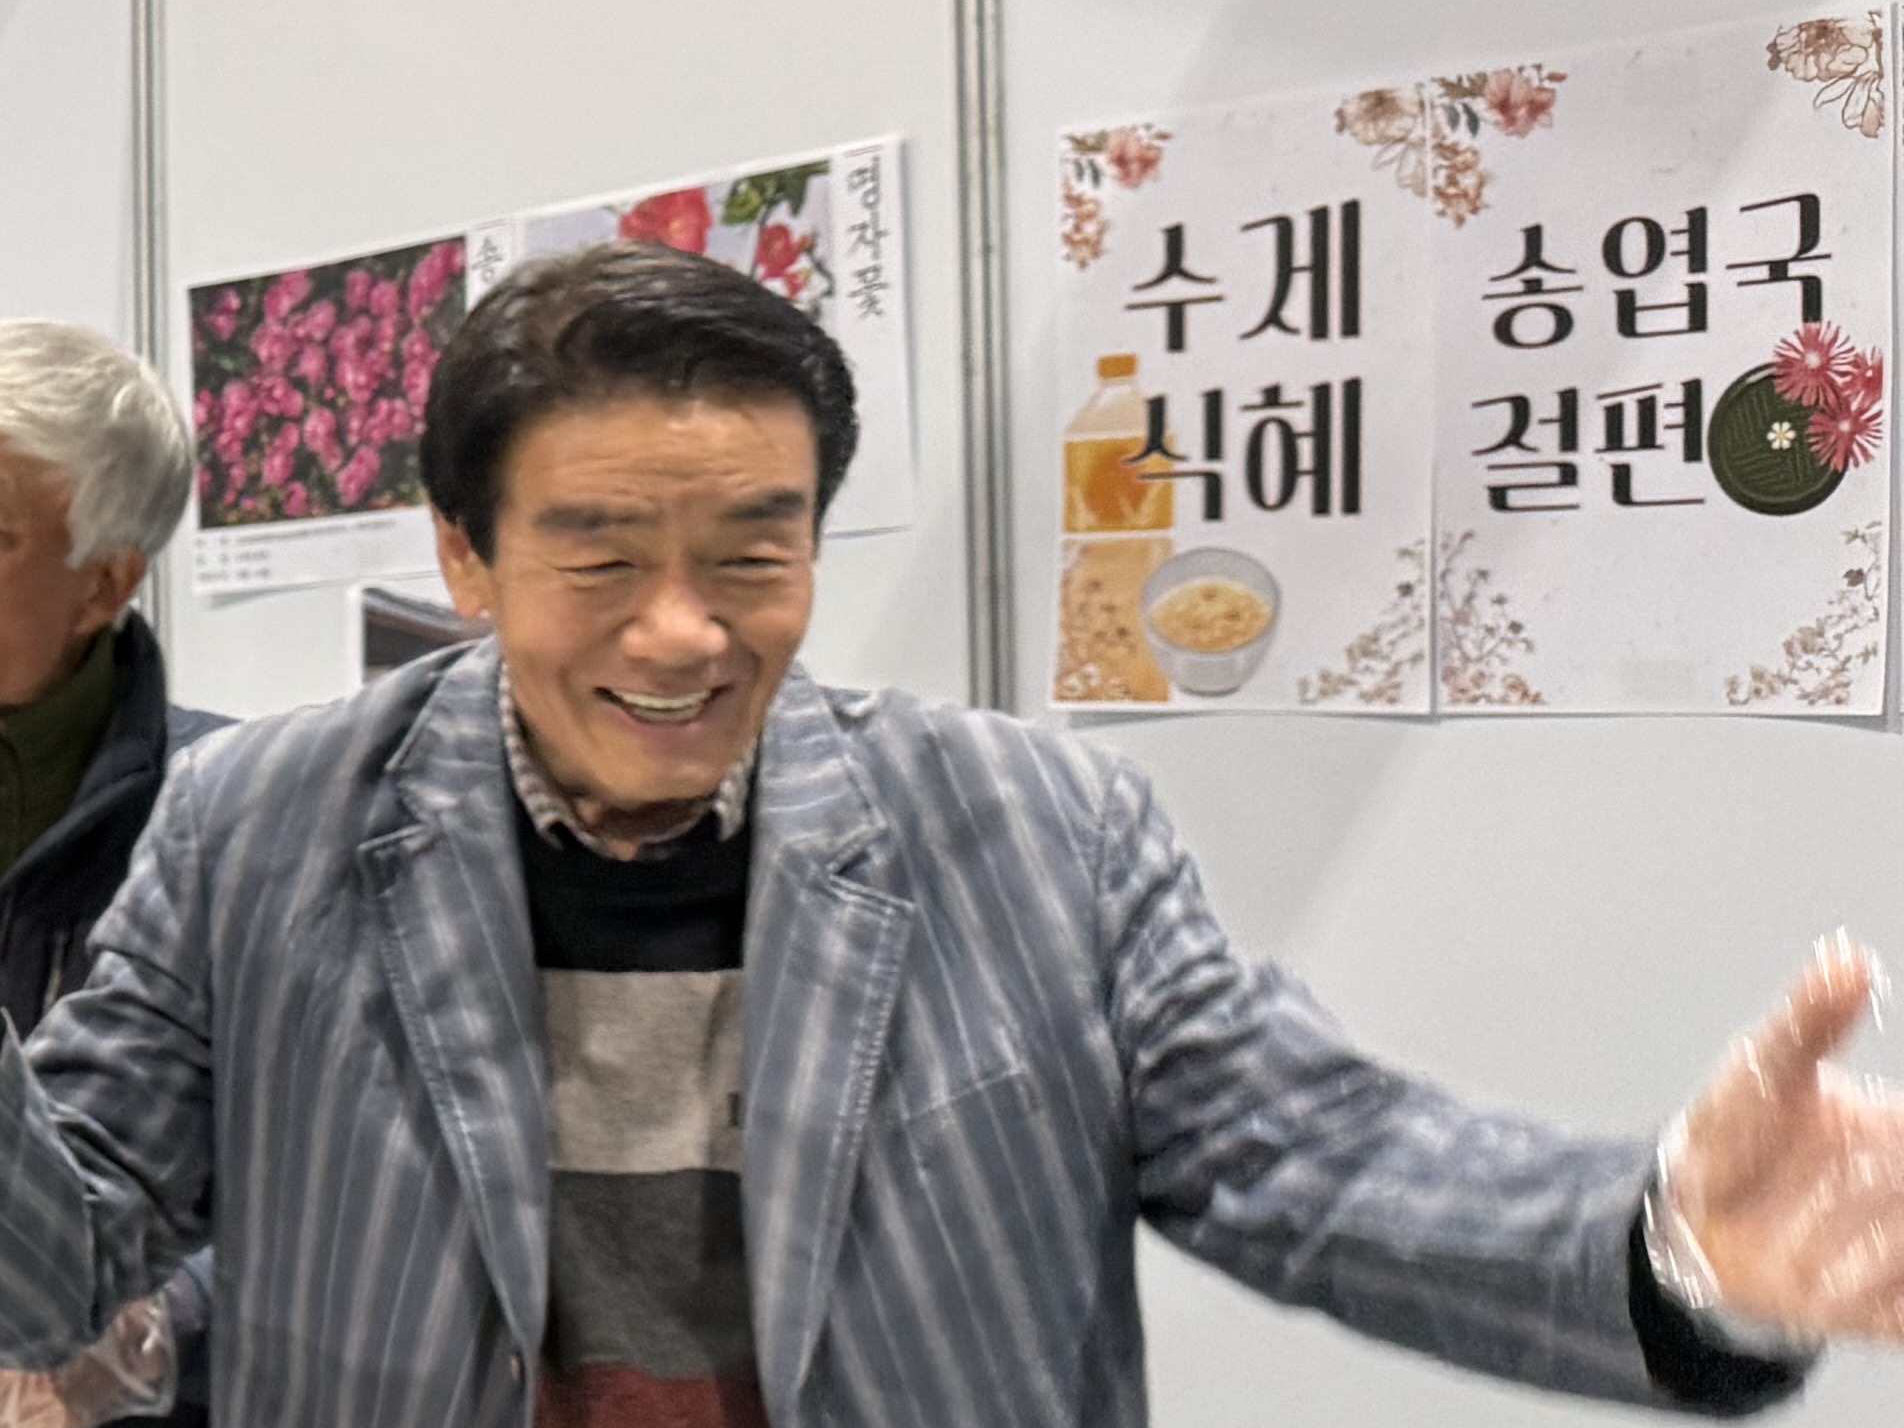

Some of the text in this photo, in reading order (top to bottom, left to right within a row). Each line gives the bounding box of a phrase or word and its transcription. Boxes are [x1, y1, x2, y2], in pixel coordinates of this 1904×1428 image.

[1124, 198, 1363, 353] 수제
[1480, 193, 1833, 350] 송엽국
[1122, 376, 1363, 522] 식혜
[1470, 378, 1706, 515] 절편
